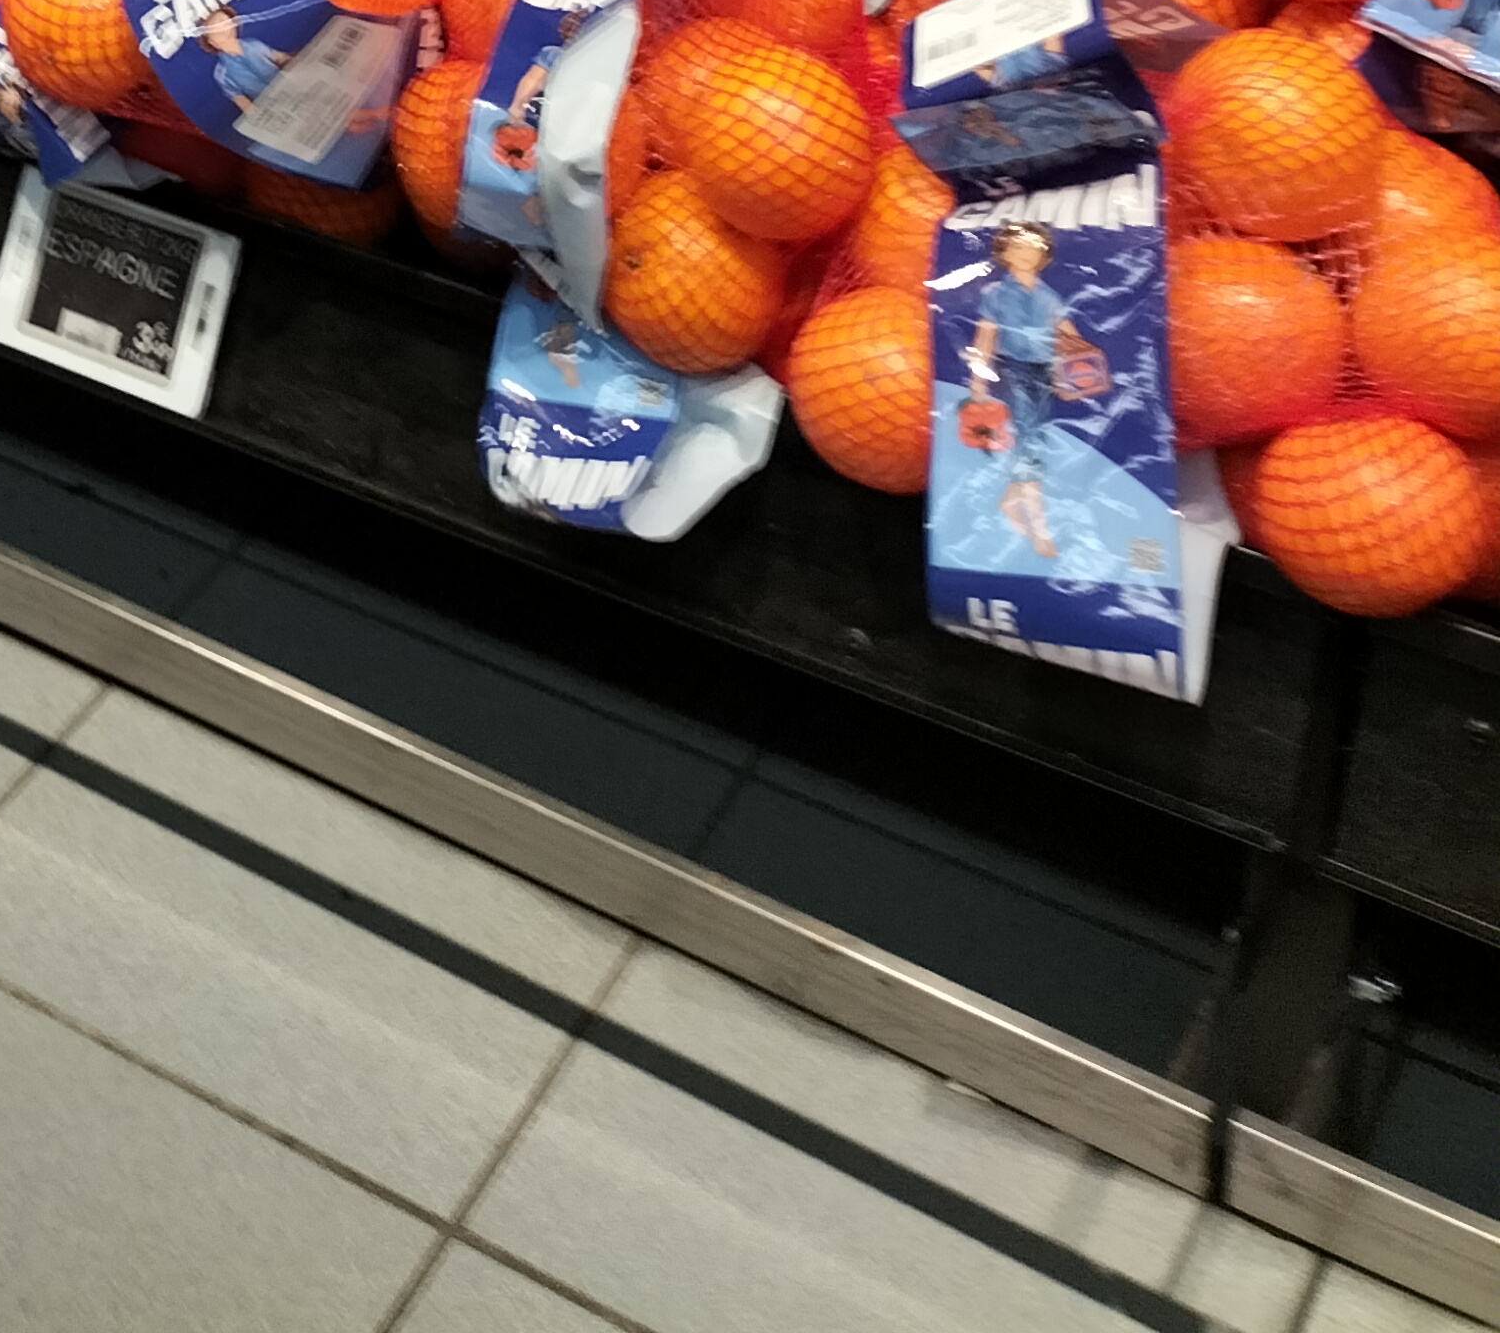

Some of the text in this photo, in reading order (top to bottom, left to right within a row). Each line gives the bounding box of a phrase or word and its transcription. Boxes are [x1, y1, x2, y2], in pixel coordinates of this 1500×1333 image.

[943, 163, 1157, 232] GAMIN
[43, 226, 179, 300] ESPAGNE
[499, 413, 541, 452] LE
[487, 445, 653, 512] GAMIN
[966, 597, 1019, 635] LE
